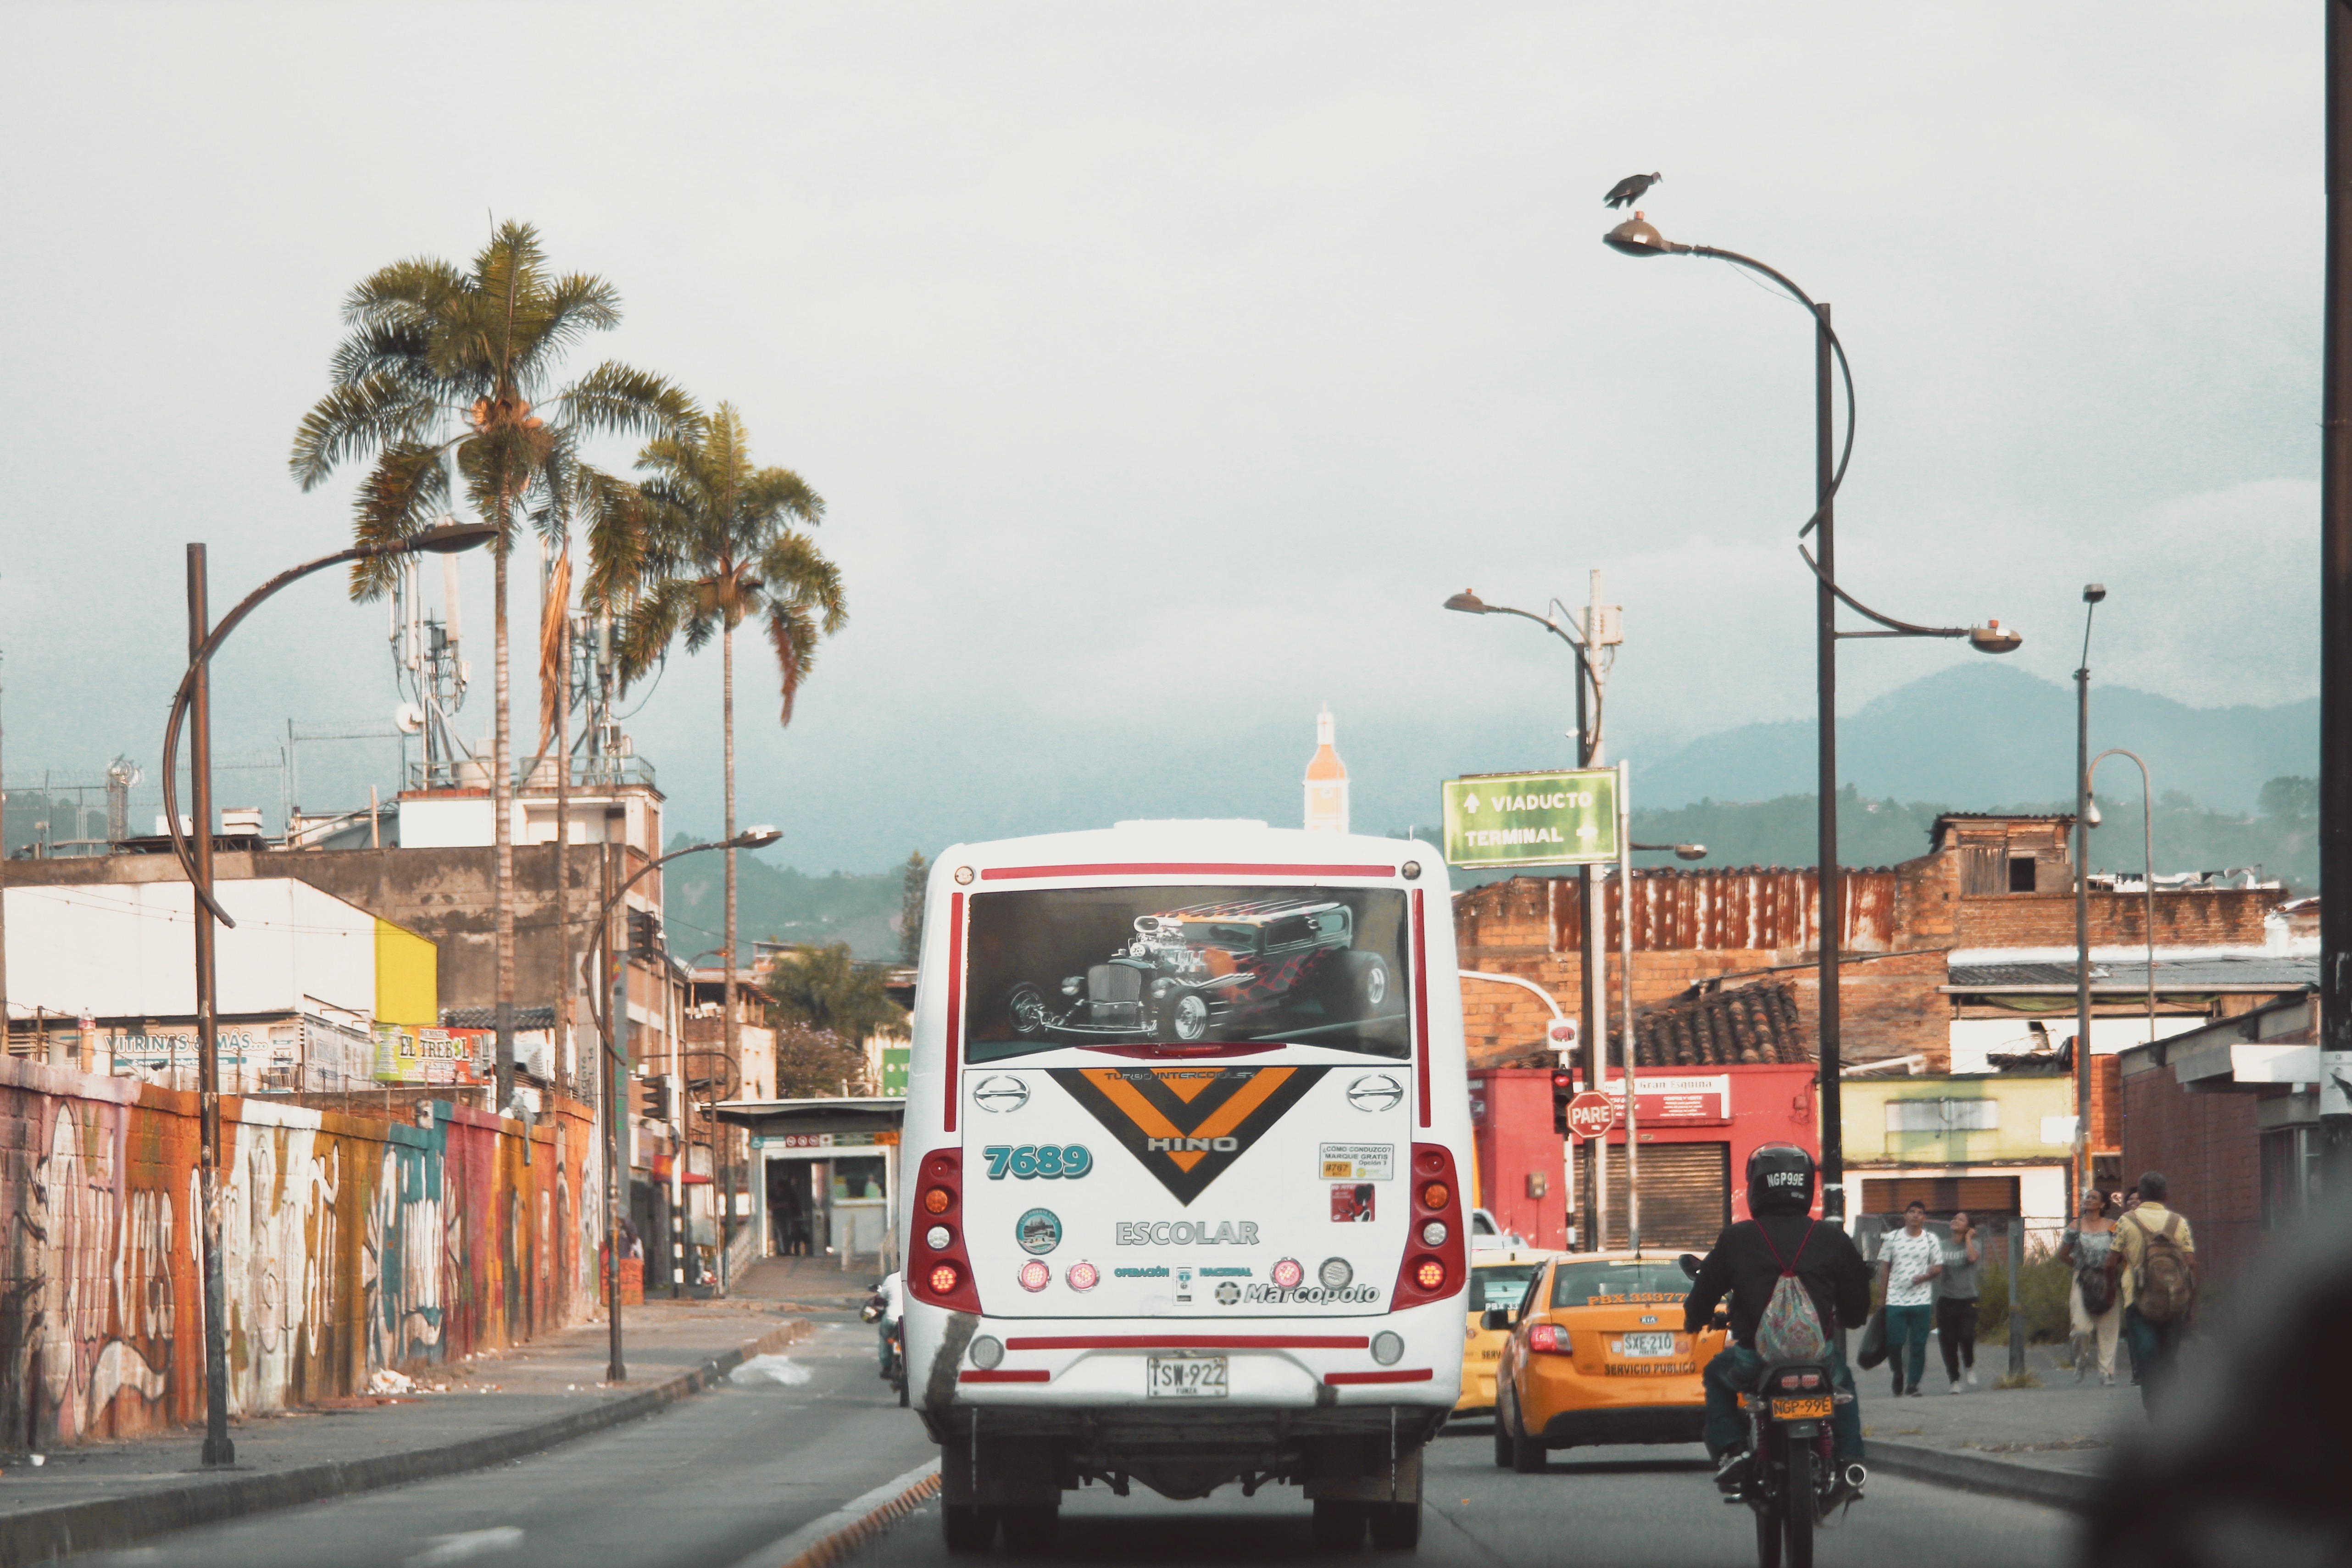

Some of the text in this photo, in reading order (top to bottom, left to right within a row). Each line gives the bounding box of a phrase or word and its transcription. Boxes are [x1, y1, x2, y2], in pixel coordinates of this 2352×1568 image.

[1491, 792, 1593, 812] VIADUCTO
[1464, 828, 1564, 846] TERMINAL
[105, 1034, 189, 1053] VITRINAS
[1671, 1079, 1712, 1090] Esquina
[1572, 1106, 1610, 1124] PARE
[1148, 1136, 1238, 1152] HINO
[983, 1143, 1093, 1180] 7689
[1767, 1172, 1804, 1187] NGP99E
[1116, 1221, 1260, 1246] ESCOLAR
[1114, 1265, 1169, 1277] OPERACIÓN
[1244, 1284, 1380, 1305] Marcopolo
[1587, 1292, 1689, 1306] PBX 33377
[1485, 1302, 1504, 1311] PBX
[1624, 1334, 1671, 1350] SXE-210
[1150, 1363, 1225, 1386] TSW-922
[1605, 1363, 1651, 1375] SERVICIO
[1773, 1399, 1830, 1415] NGP-99E
